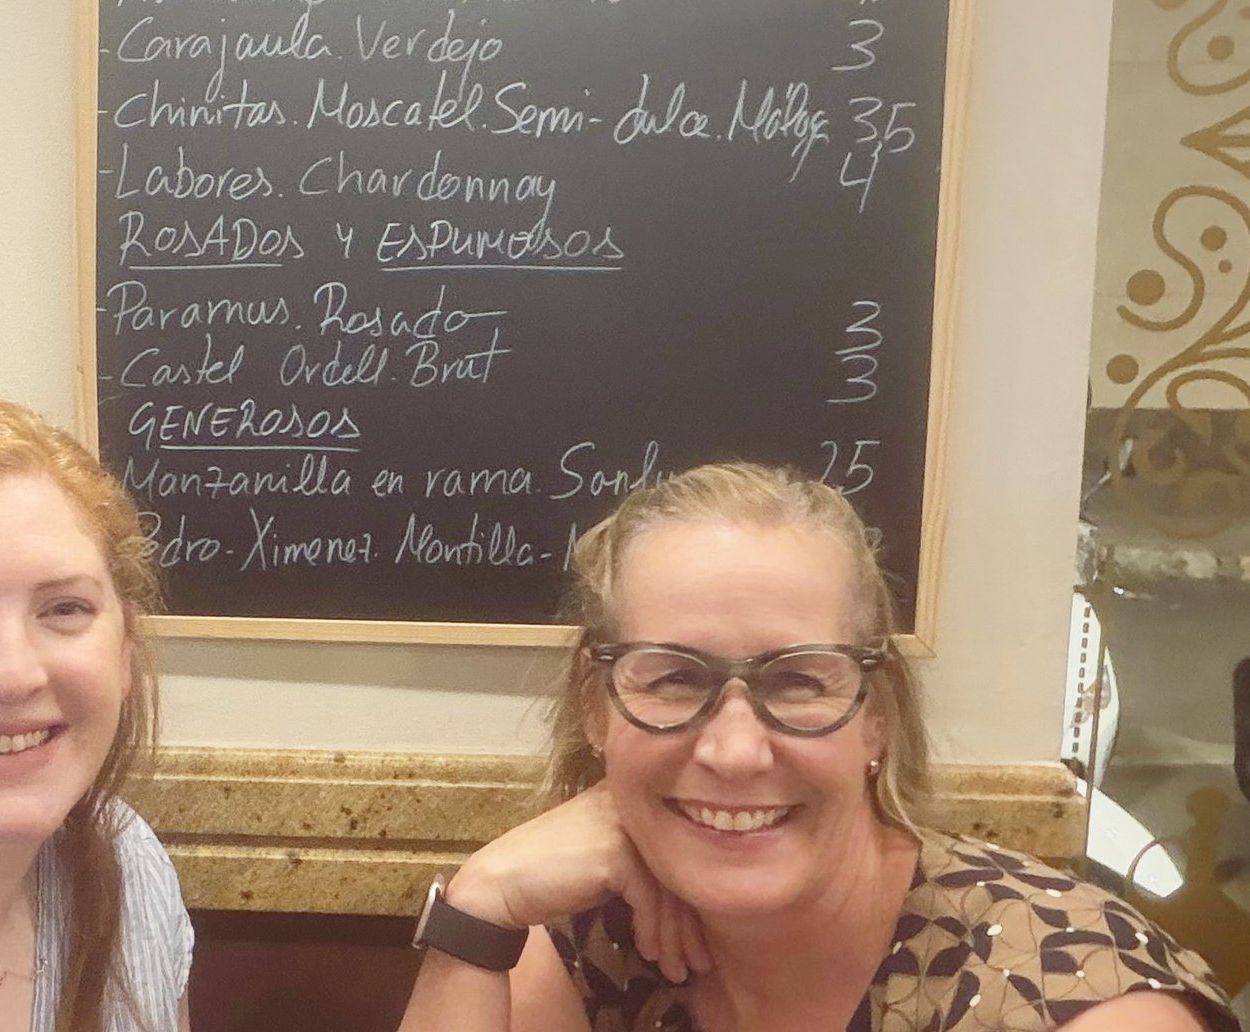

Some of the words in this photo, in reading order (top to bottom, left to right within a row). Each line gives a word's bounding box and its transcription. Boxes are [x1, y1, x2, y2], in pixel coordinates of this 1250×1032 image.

[832, 19, 884, 71] 3
[839, 142, 881, 214] 4
[313, 281, 509, 339] Rosado
[834, 300, 884, 355] 3
[119, 333, 246, 388] Castel
[405, 327, 513, 388] Brut
[826, 353, 879, 403] 3
[128, 398, 362, 451] GENEROSOS
[371, 472, 405, 497] en
